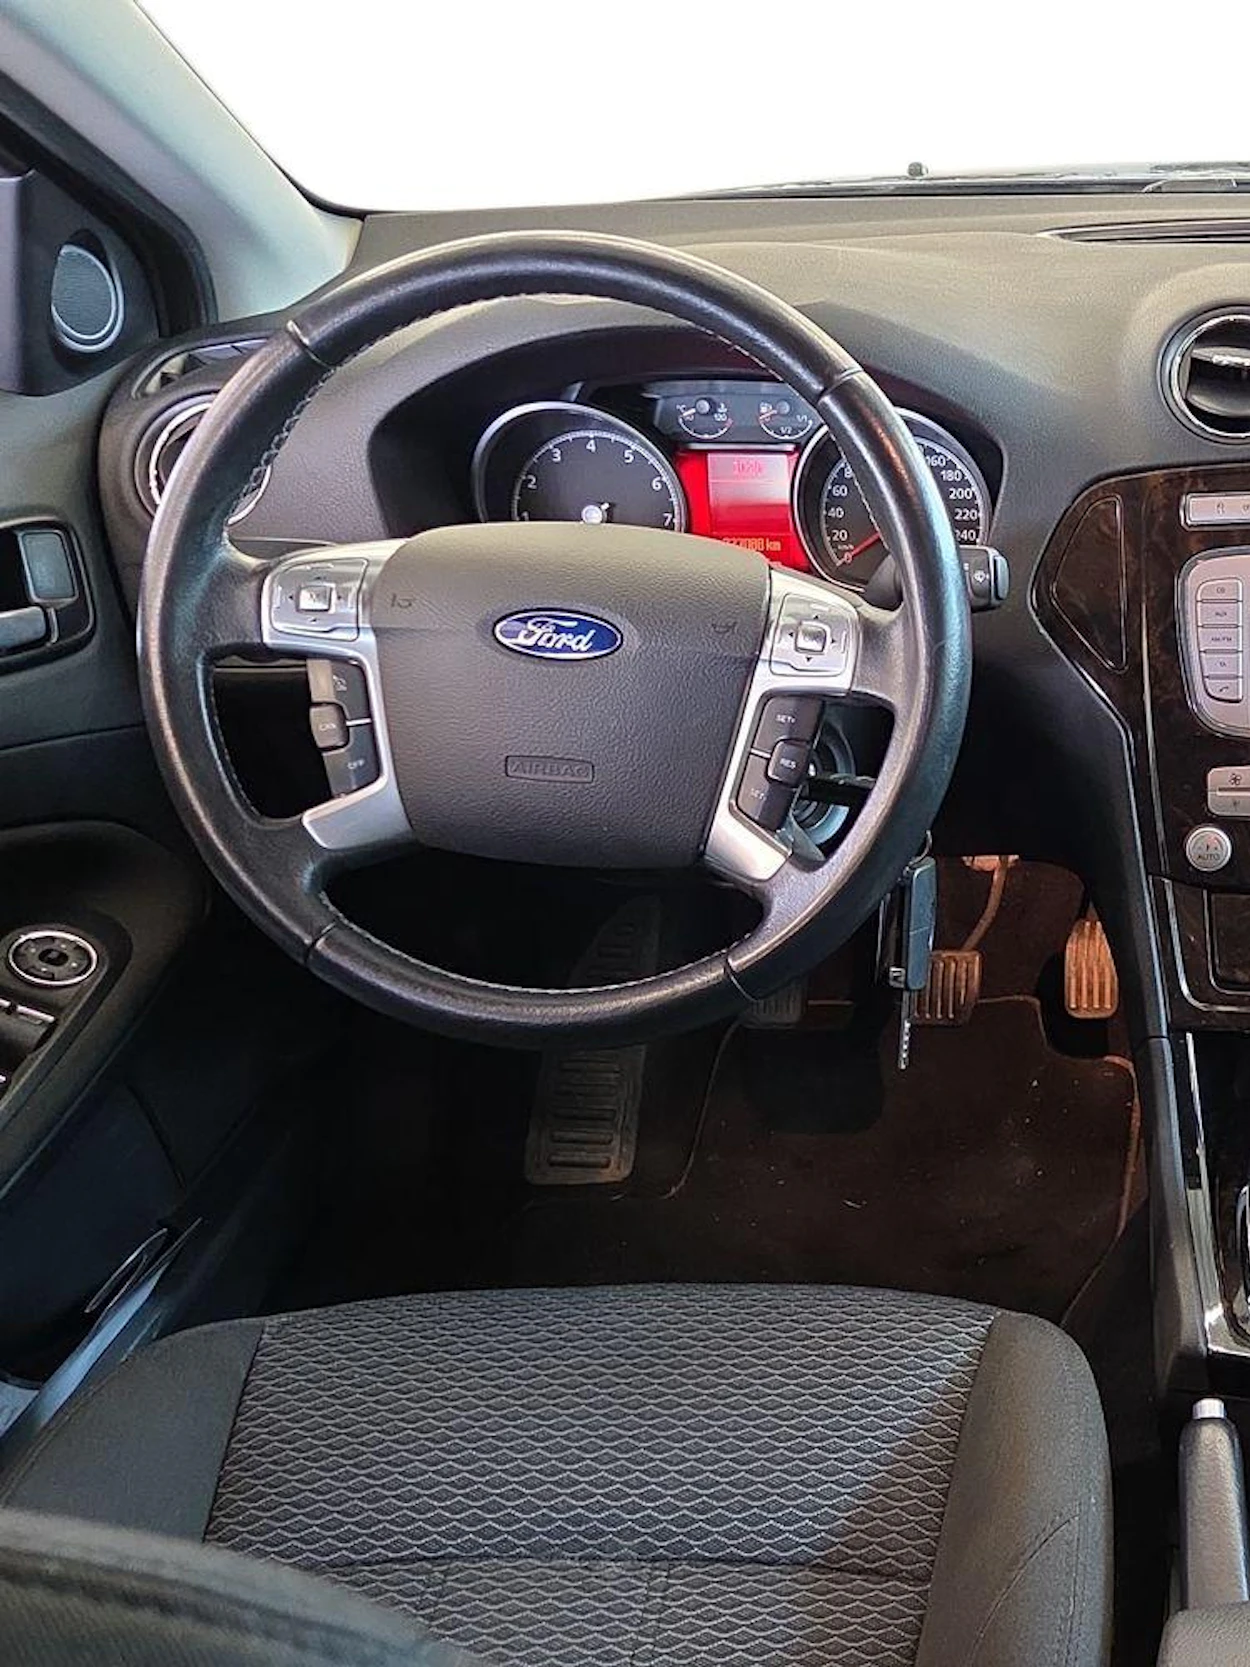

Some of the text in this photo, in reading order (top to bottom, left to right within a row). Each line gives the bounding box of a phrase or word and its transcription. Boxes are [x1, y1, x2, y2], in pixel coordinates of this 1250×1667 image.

[586, 440, 596, 453] 4
[551, 449, 562, 462] 3
[624, 450, 634, 463] 5
[527, 475, 538, 489] 2
[941, 469, 962, 482] 180
[651, 477, 662, 491] 6
[832, 484, 848, 497] 60
[949, 488, 973, 500] 200
[828, 506, 845, 518] 40
[954, 508, 978, 521] 220
[662, 513, 673, 526] 7
[832, 529, 848, 542] 20
[766, 537, 781, 551] km
[506, 616, 597, 651] Ford
[510, 761, 588, 777] AIRBAG
[780, 757, 797, 770] RES
